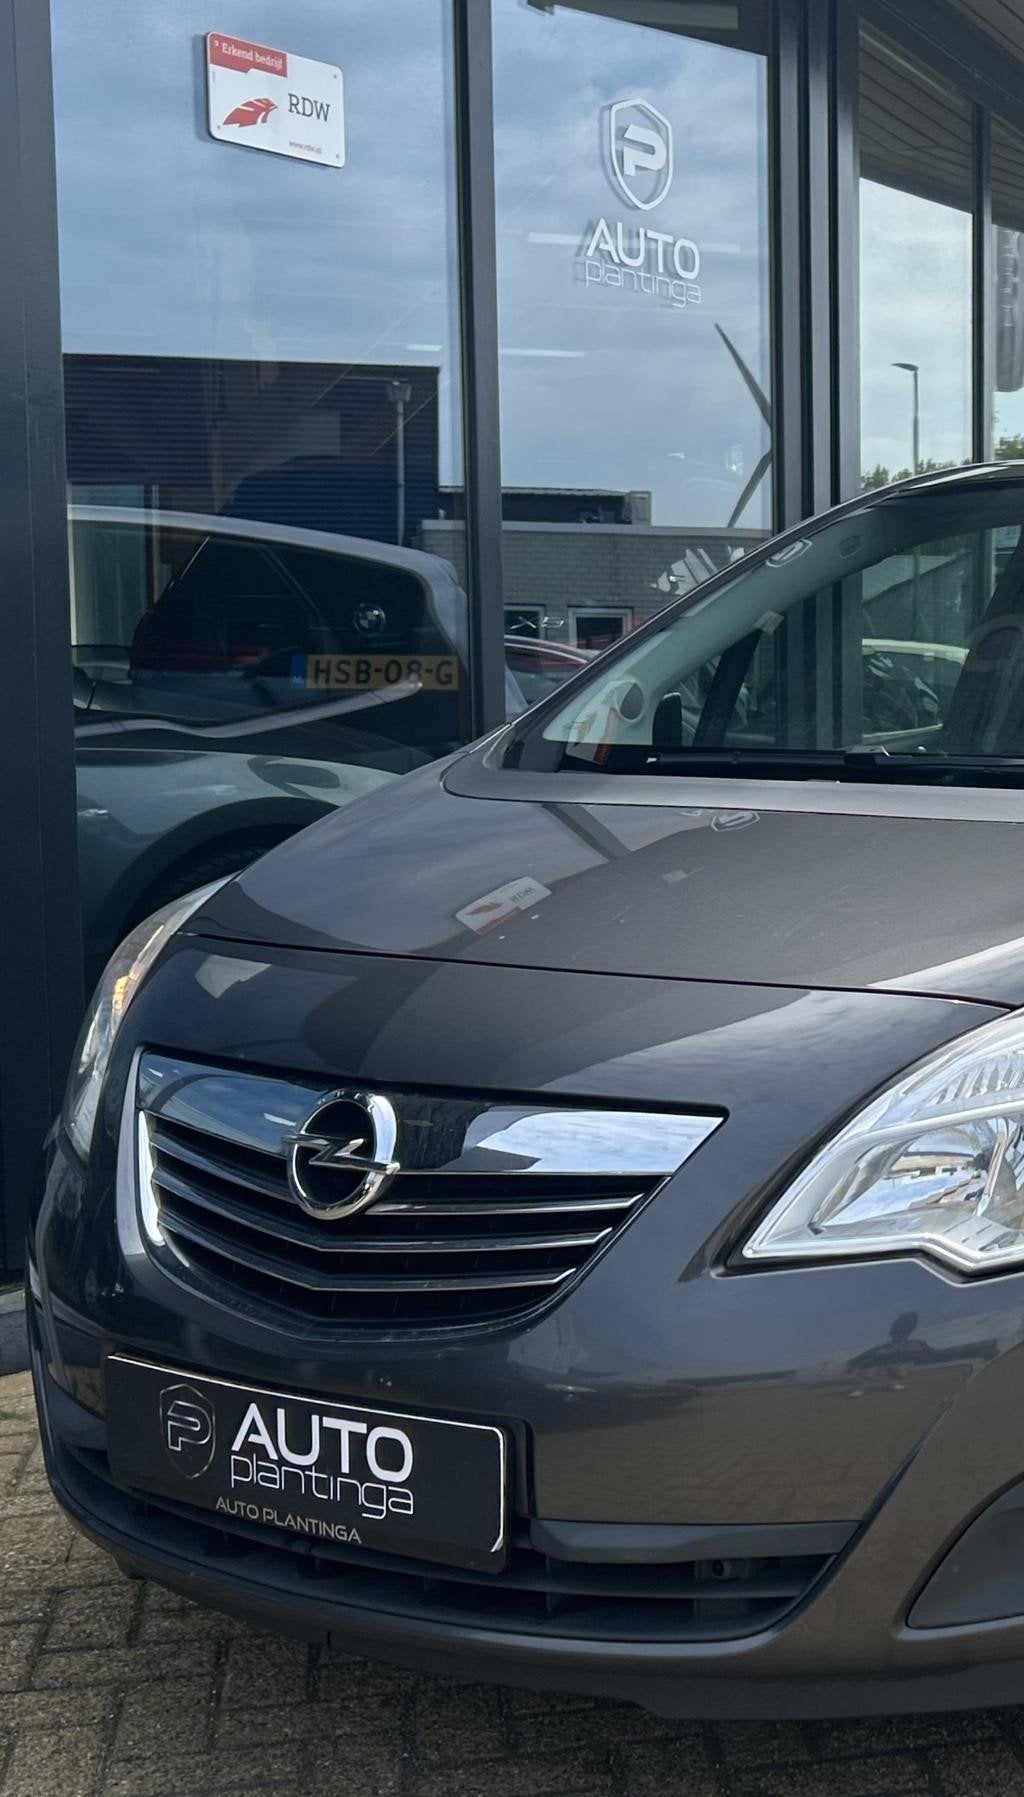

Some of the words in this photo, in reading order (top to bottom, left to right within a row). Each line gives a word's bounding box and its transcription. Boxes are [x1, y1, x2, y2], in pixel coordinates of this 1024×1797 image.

[222, 43, 253, 61] Erkend
[255, 51, 283, 70] bedrijf
[288, 93, 331, 122] RDW
[586, 217, 700, 280] AUTO
[585, 259, 701, 308] plantinga
[313, 659, 453, 685] HSB-08-G
[231, 1402, 414, 1483] AUTO
[230, 1454, 415, 1520] plantinga
[215, 1495, 259, 1519] AUTO
[262, 1507, 362, 1545] PLANTINGA
